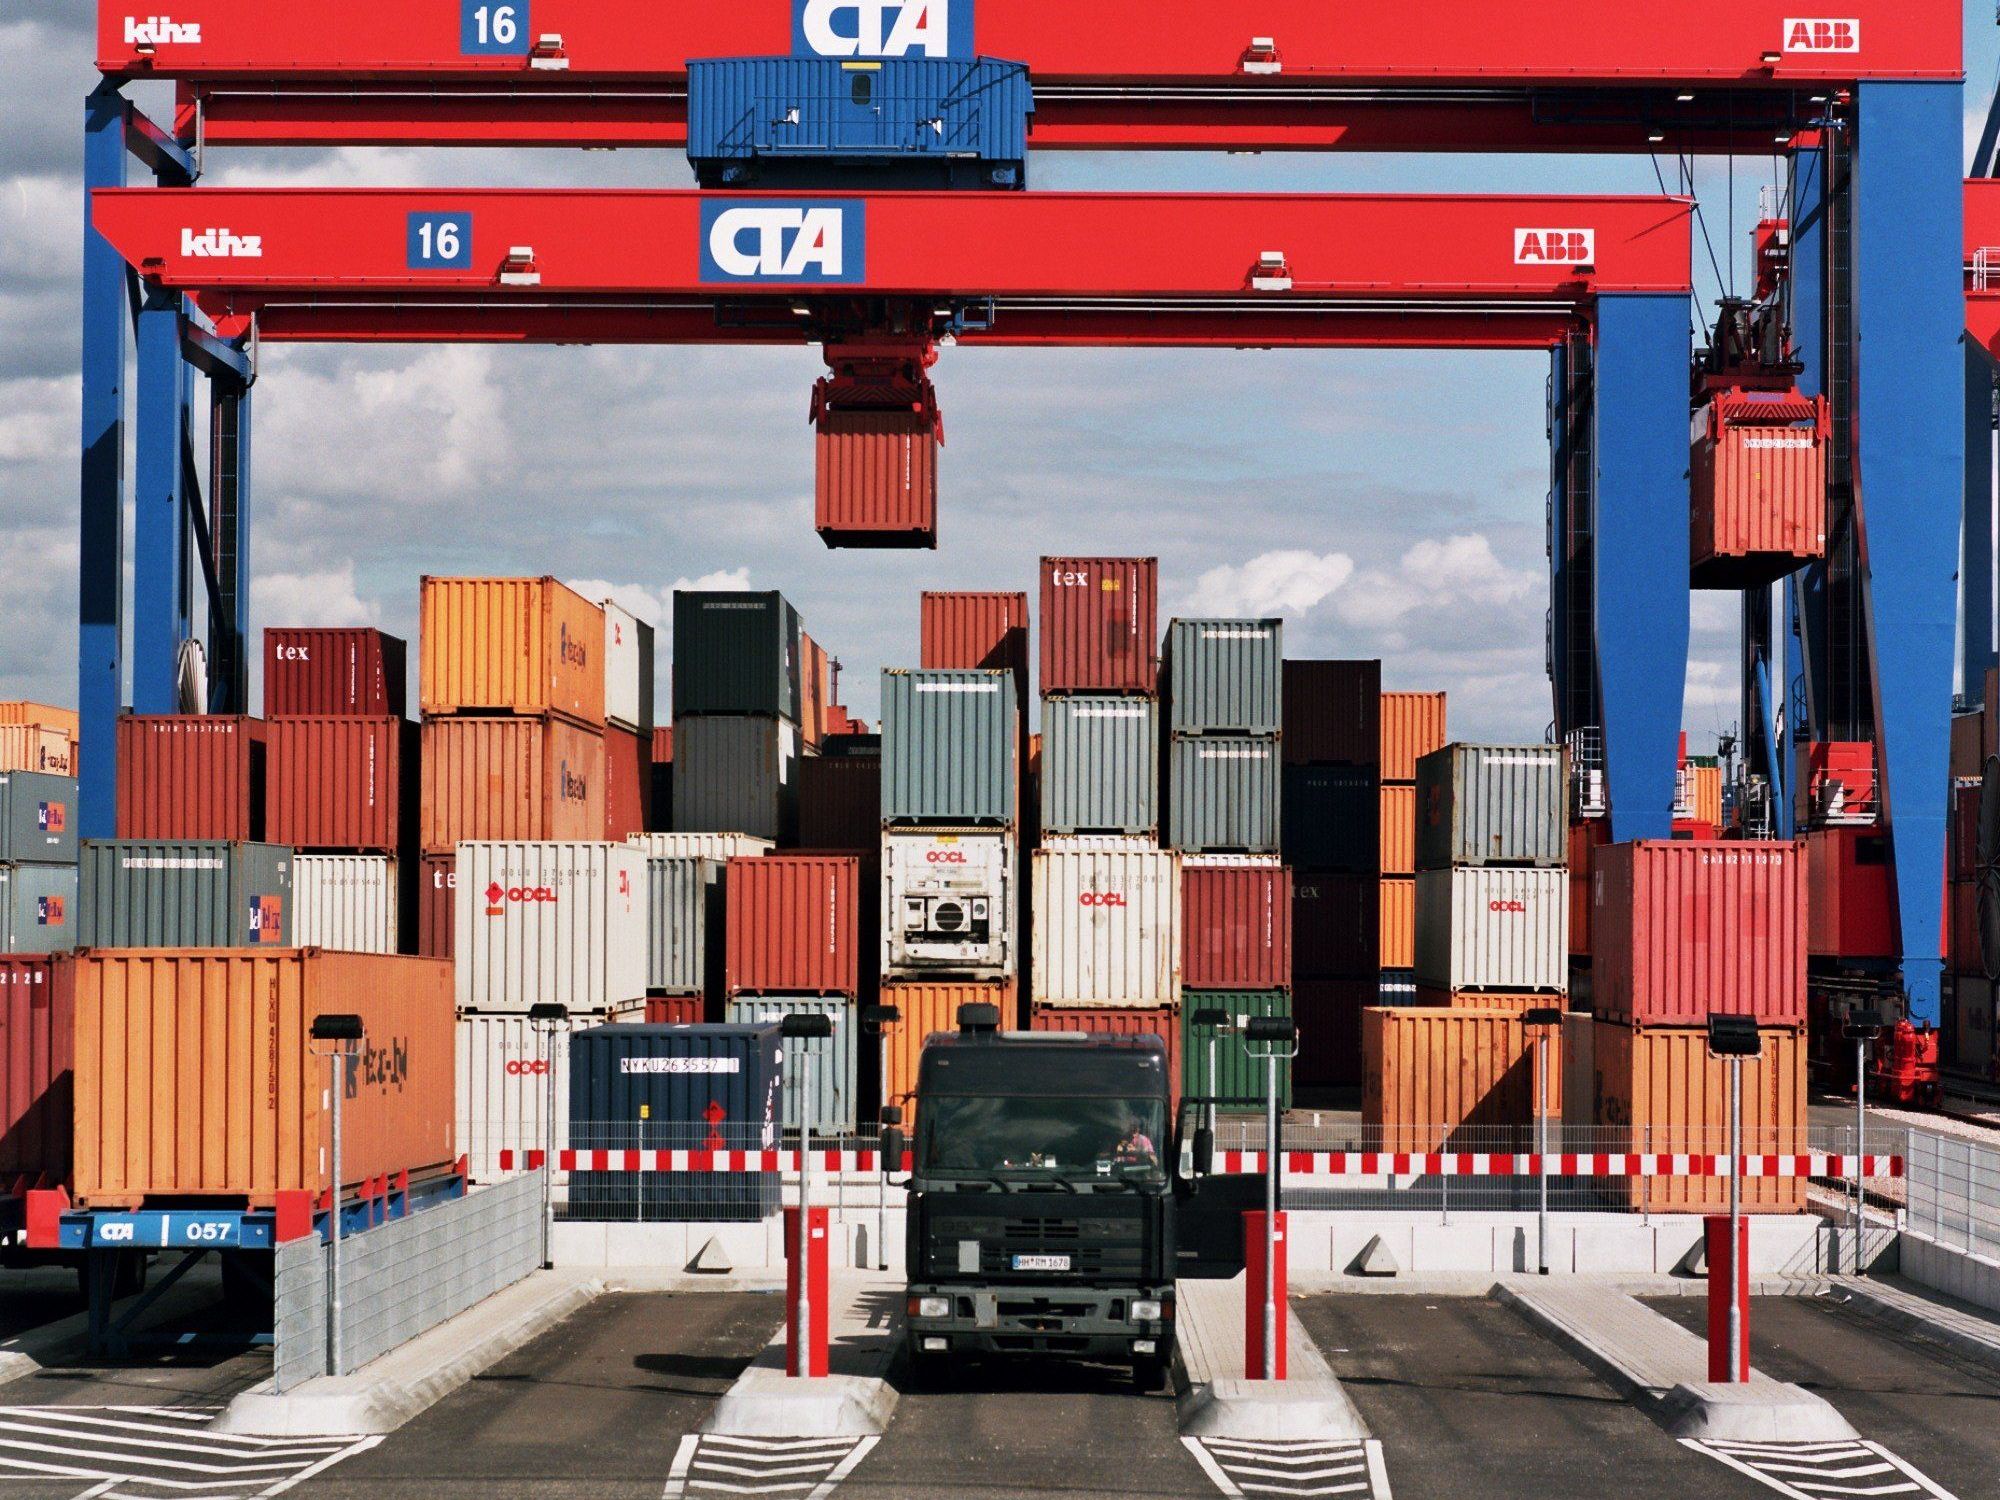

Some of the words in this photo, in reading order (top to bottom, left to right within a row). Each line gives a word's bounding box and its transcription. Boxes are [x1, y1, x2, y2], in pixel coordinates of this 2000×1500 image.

[473, 5, 517, 44] 16
[802, 0, 948, 57] CTA
[1787, 22, 1855, 49] ABB
[418, 222, 459, 259] 16
[709, 207, 842, 275] CTA
[1518, 232, 1589, 260] ABB
[1053, 568, 1088, 587] tex
[276, 643, 309, 661] tex
[926, 851, 967, 863] OOCL
[433, 870, 456, 889] te
[508, 887, 558, 902] OOCL
[1080, 892, 1127, 907] OOCL
[1490, 901, 1526, 912] OOCL
[100, 1223, 134, 1240] CTA
[186, 1223, 231, 1240] 057
